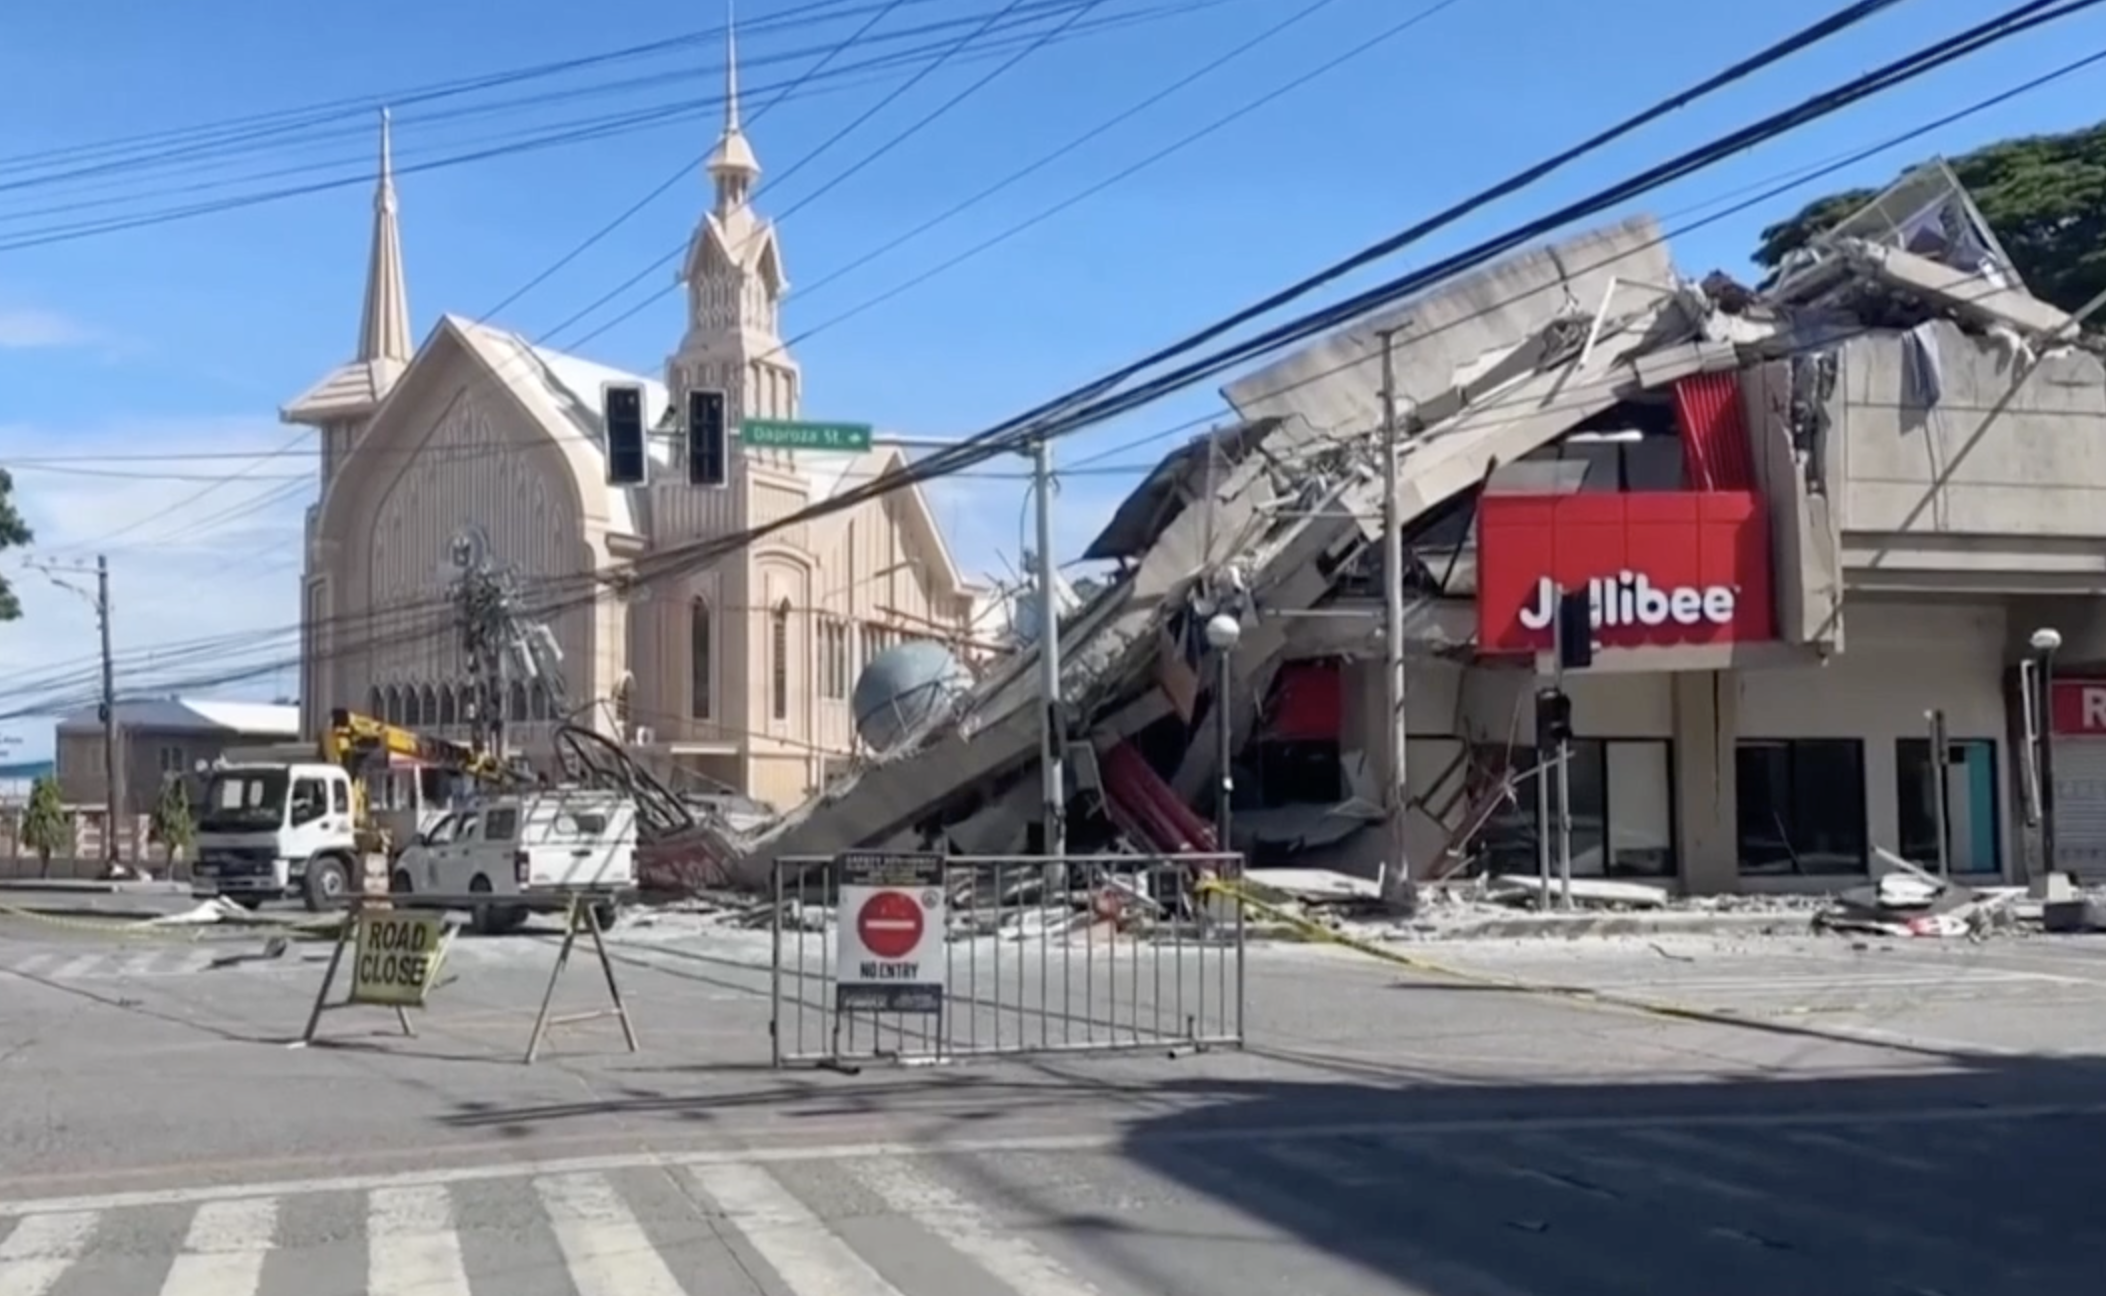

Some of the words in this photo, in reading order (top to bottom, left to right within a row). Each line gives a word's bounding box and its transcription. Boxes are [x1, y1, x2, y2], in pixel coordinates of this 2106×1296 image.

[1519, 569, 1736, 629] Jllibee
[368, 921, 427, 952] ROAD
[361, 953, 429, 987] CLOSE
[859, 961, 877, 979] NO
[879, 961, 920, 979] ENTRY
